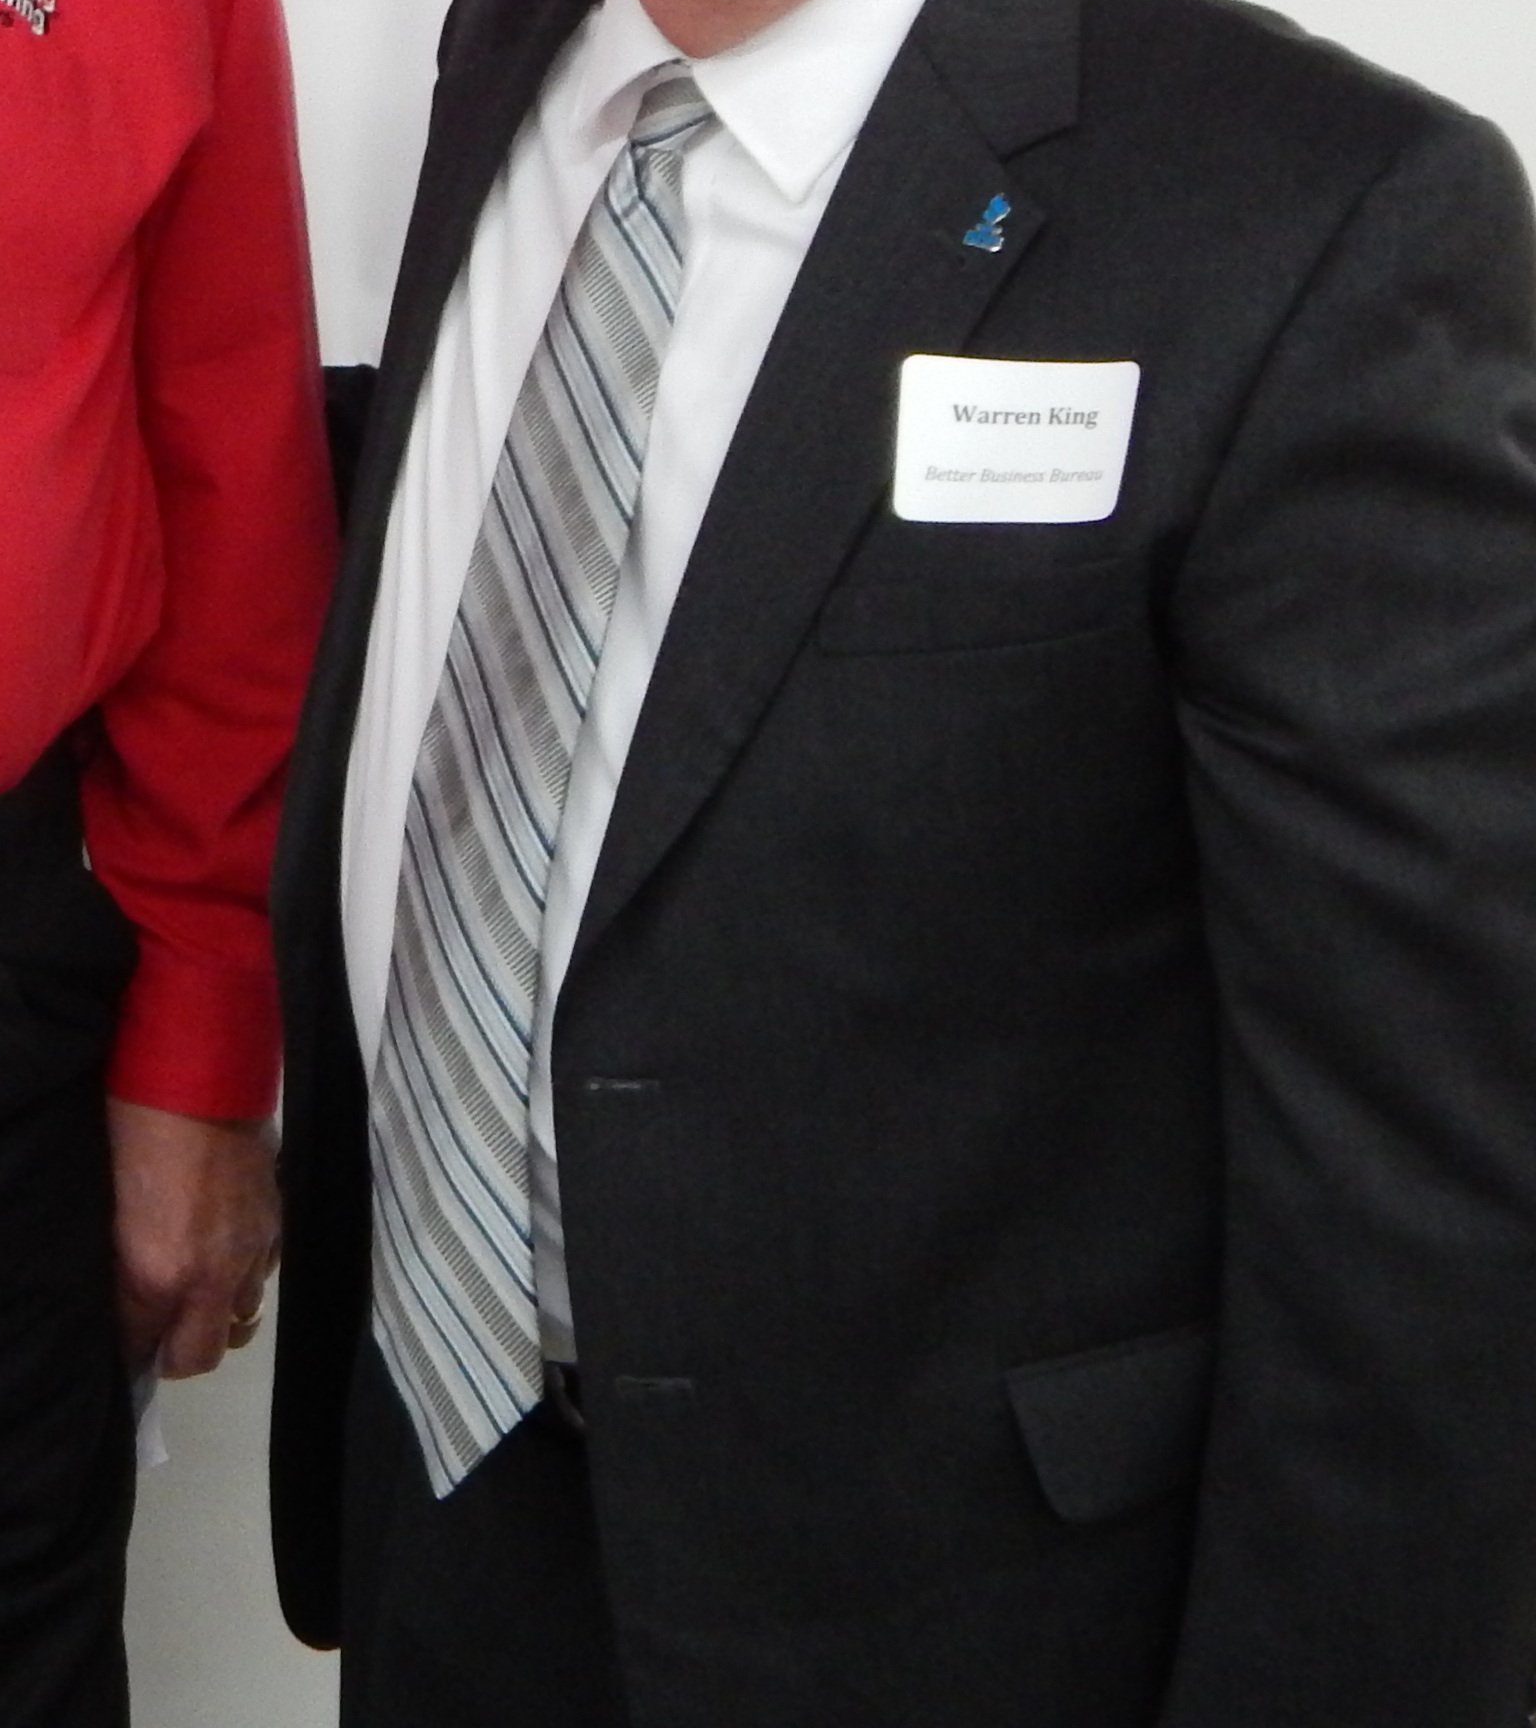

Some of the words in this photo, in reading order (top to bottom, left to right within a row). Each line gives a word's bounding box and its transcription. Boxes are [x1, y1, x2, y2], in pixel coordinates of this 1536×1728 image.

[952, 404, 1041, 426] Warren
[1048, 406, 1100, 430] King
[924, 465, 977, 483] Better
[1049, 468, 1103, 483] Bureau
